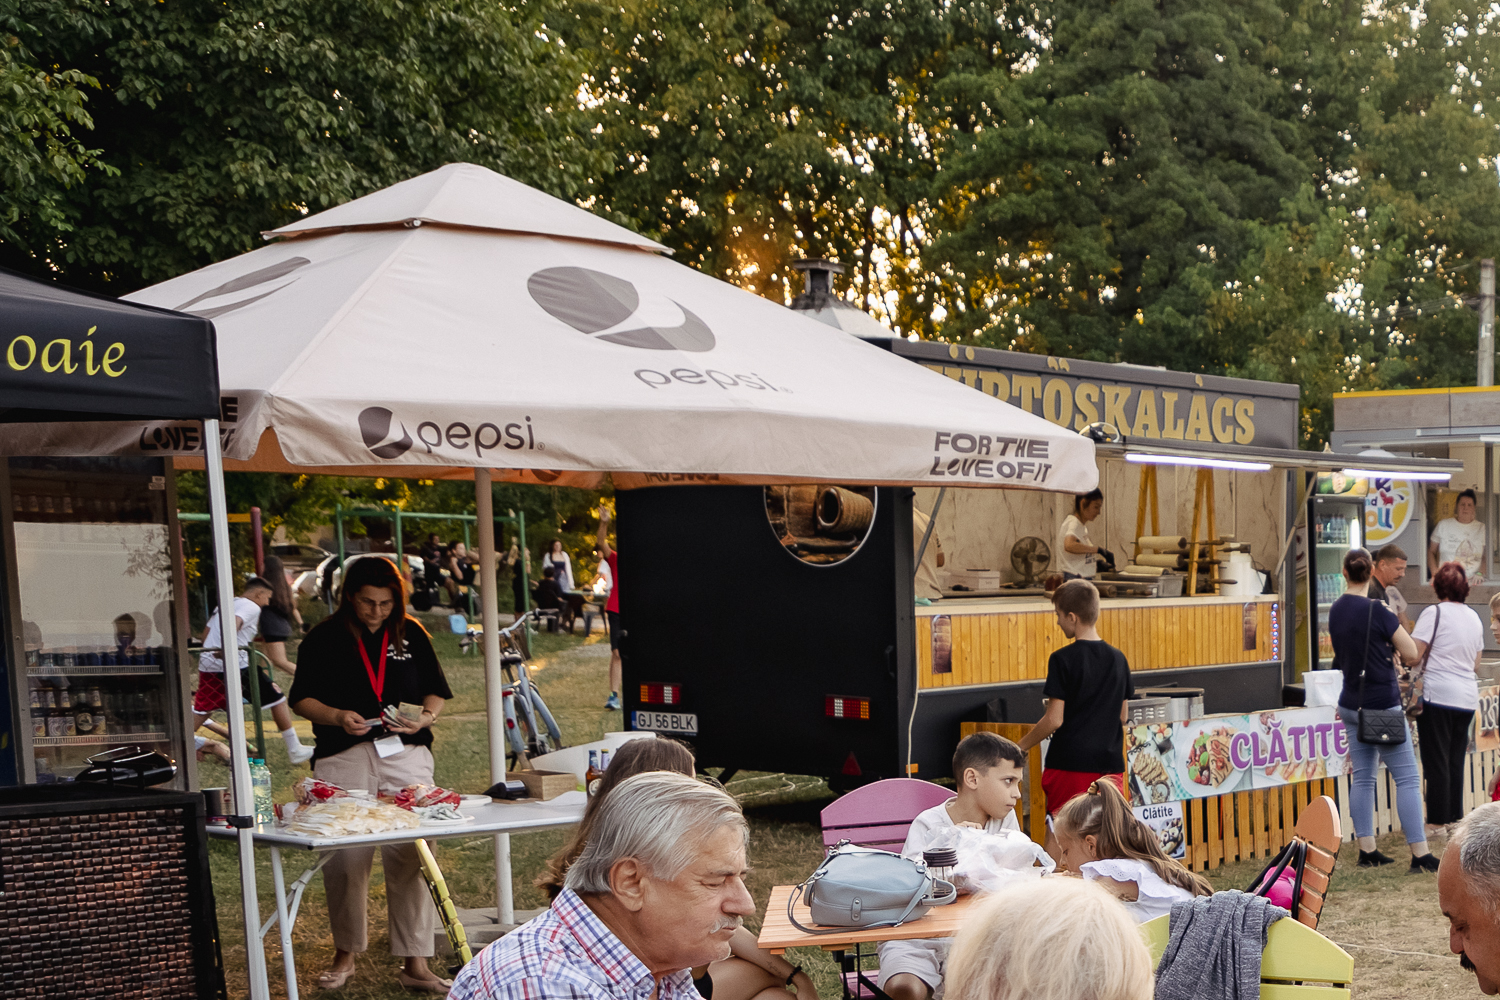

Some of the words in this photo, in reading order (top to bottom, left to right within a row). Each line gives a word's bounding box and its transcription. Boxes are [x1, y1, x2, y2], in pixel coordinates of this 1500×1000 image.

[6, 325, 127, 378] oaie
[633, 368, 779, 392] pepsi
[922, 344, 1255, 445] TŐSKALÁCS
[139, 426, 200, 452] LOVE
[416, 415, 535, 458] pepsi
[934, 431, 992, 455] FOR
[996, 436, 1049, 459] THE
[929, 456, 994, 478] LOVE
[996, 461, 1035, 479] OF
[1034, 462, 1053, 483] IT
[637, 713, 652, 728] GJ
[655, 714, 669, 729] 56
[671, 715, 695, 731] BLK
[1230, 719, 1350, 770] CLĂTITE
[1142, 805, 1174, 820] Clătite
